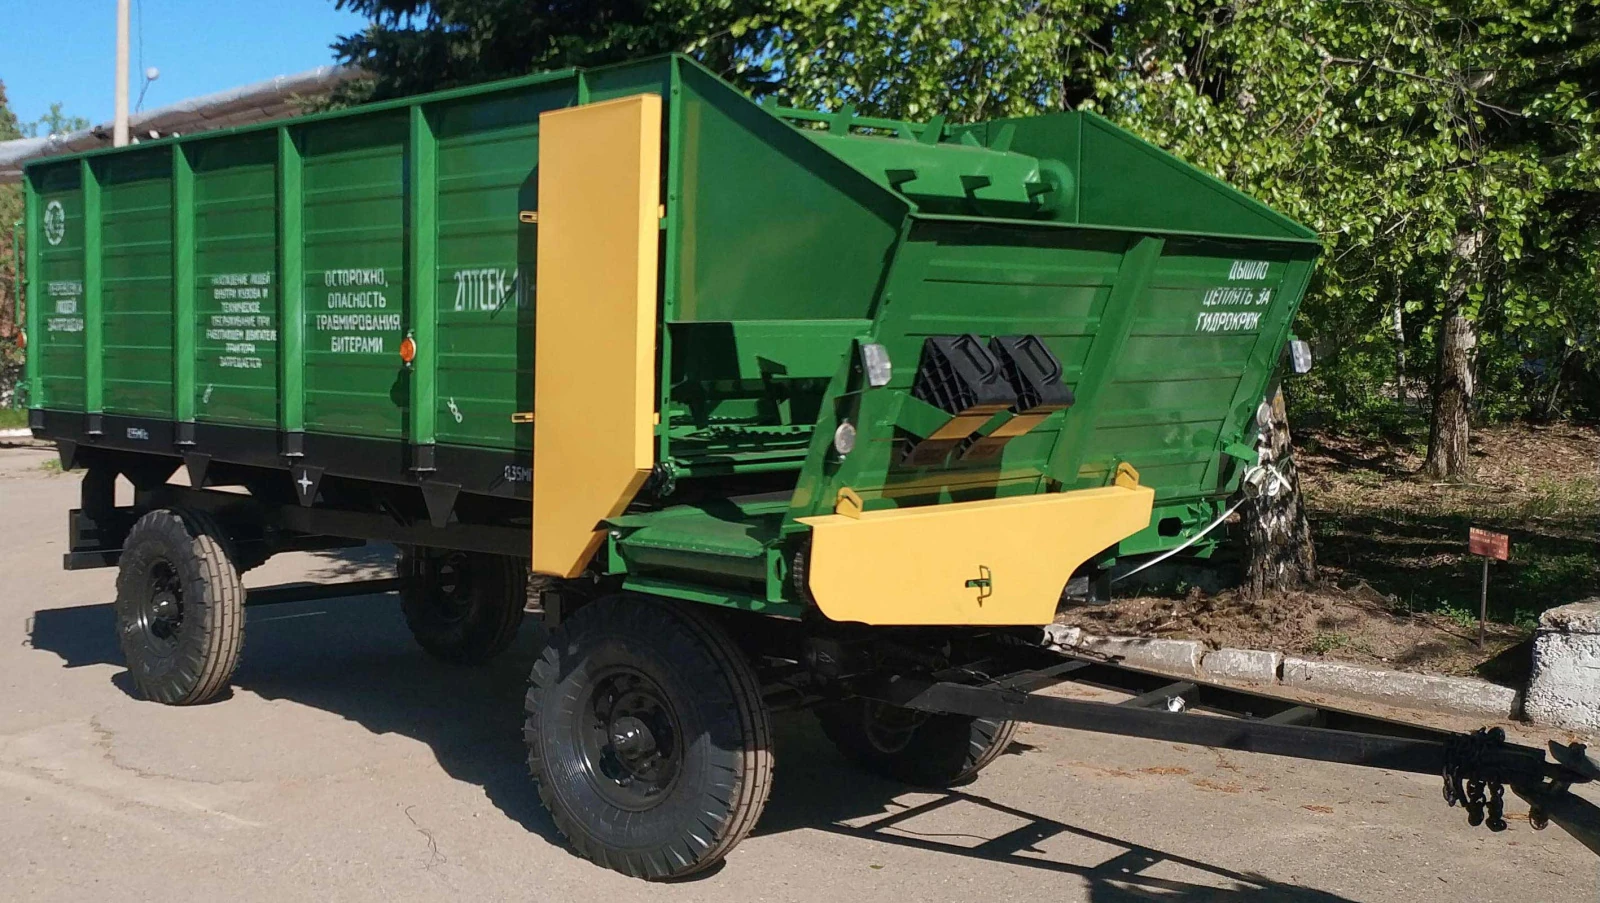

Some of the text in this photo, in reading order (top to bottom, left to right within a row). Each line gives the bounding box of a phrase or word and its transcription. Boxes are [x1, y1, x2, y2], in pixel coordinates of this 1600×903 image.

[324, 268, 389, 287] ОСТОРОЖНО,
[1228, 260, 1269, 281] ДЫШЛО
[327, 291, 387, 309] ОПАСНОСТЬ
[1203, 287, 1272, 307] ЦЕПЛЯТЬ ЗА
[316, 313, 401, 331] ТРАВМИРОВАНИЯ
[1195, 312, 1262, 332] ГИДРОКРЮК
[331, 335, 383, 353] БИТЕРАМИ
